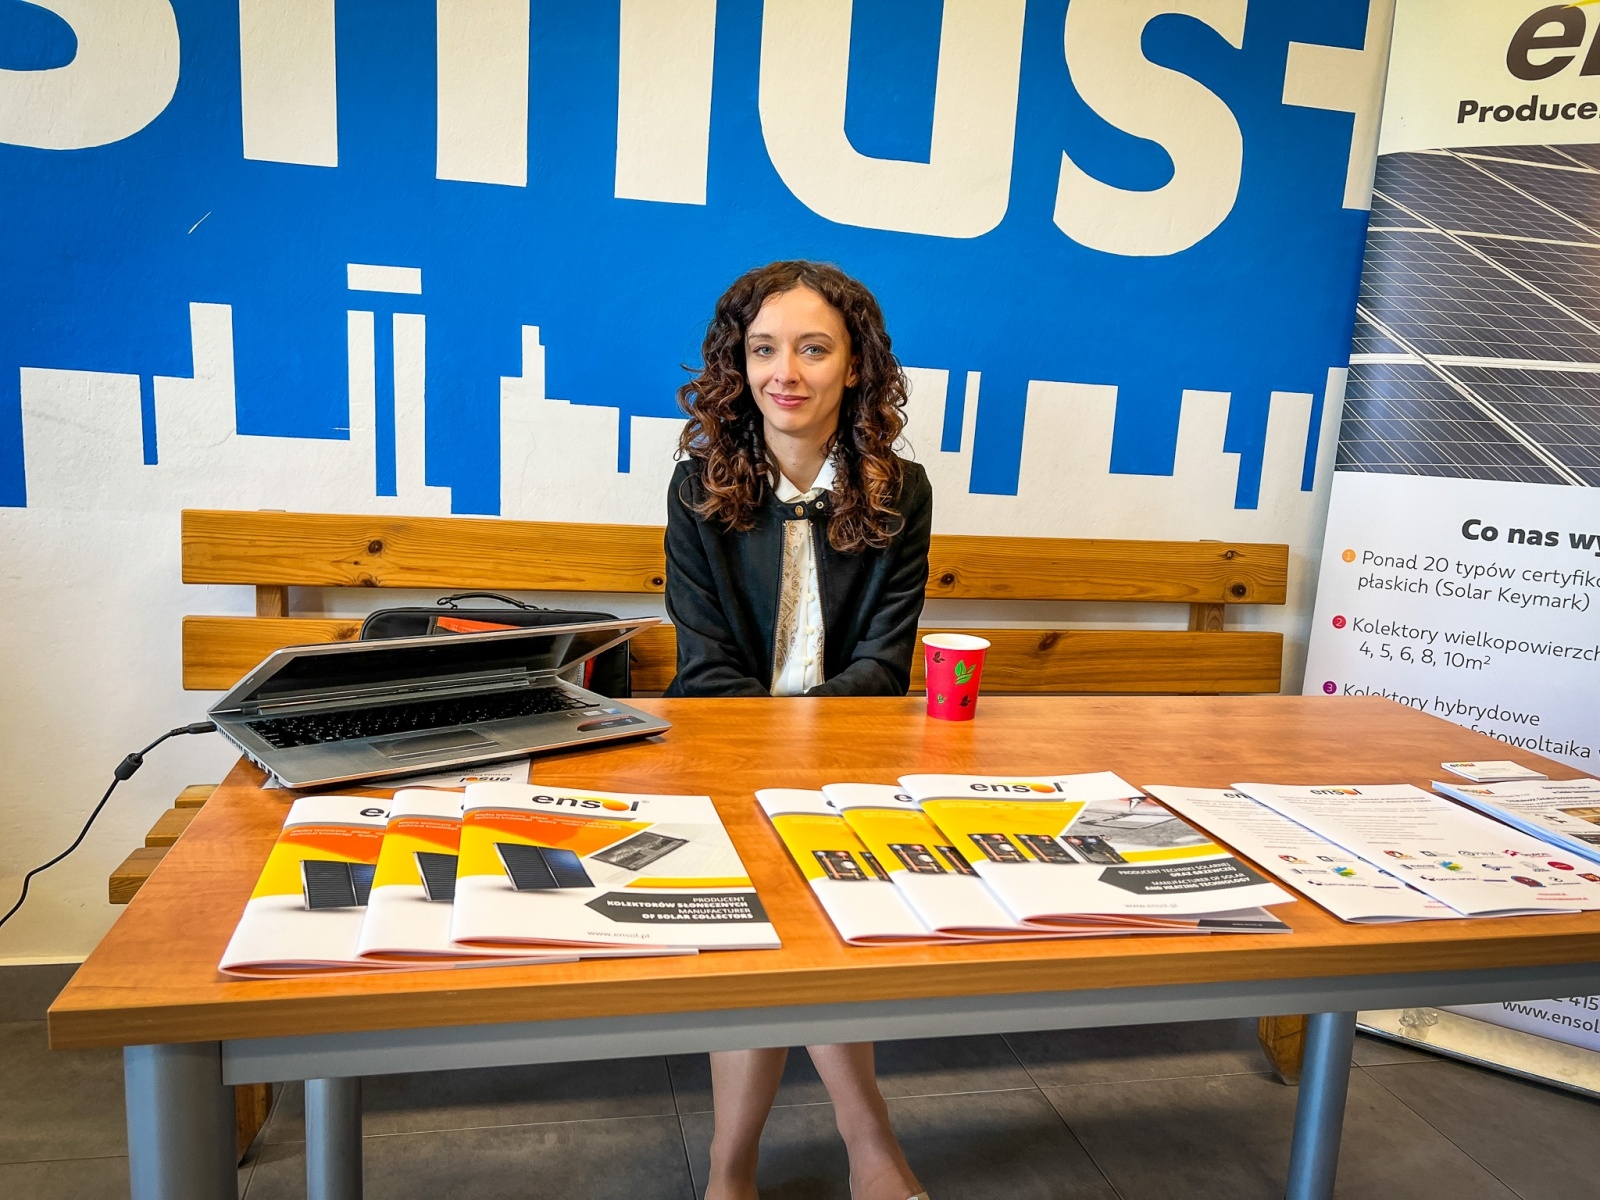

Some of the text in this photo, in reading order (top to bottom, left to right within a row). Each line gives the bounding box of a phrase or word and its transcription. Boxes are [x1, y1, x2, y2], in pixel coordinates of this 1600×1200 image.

[1506, 5, 1600, 81] e
[1457, 95, 1600, 124] Produce
[1462, 519, 1498, 542] Co
[1507, 527, 1559, 547] nas
[1362, 550, 1418, 570] Ponad
[1423, 556, 1449, 572] 20
[1455, 560, 1516, 579] typów
[1358, 573, 1590, 612] płaskich (Solar Keymark)
[1352, 617, 1438, 644] Kolektory
[1359, 641, 1374, 659] 4,
[1380, 644, 1393, 661] 5,
[1400, 646, 1415, 664] 6,
[1421, 648, 1436, 667] 8,
[1434, 696, 1540, 726] hybrydowe
[970, 782, 1064, 793] ensol
[1310, 788, 1363, 796] ensol
[532, 795, 640, 812] ensol
[1151, 877, 1210, 885] MANUFACTURER
[1221, 872, 1247, 880] SOLAR
[1201, 877, 1251, 888] TECHNOLOGY
[606, 900, 676, 908] KOLEKTORÓW
[1503, 1002, 1600, 1033] www.ensol
